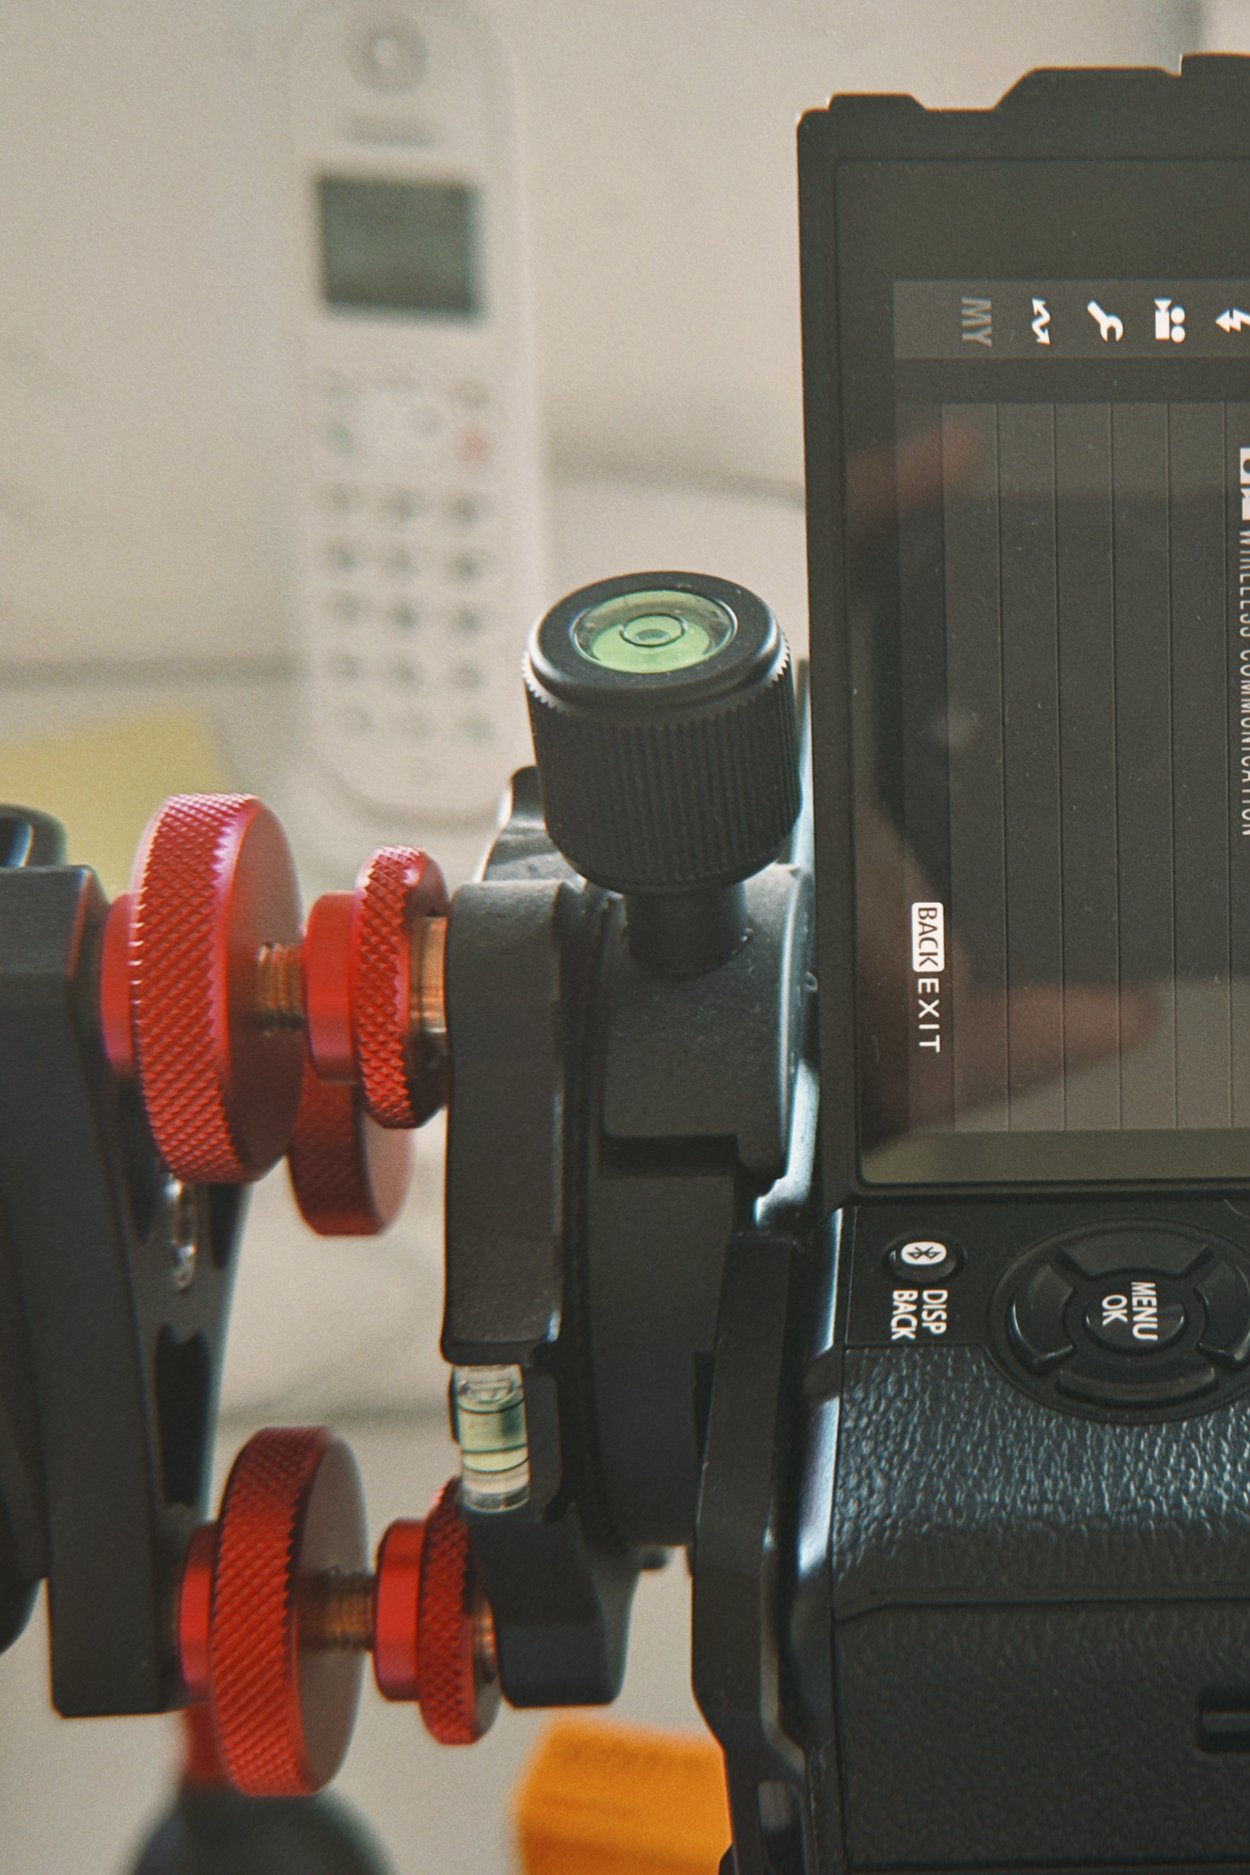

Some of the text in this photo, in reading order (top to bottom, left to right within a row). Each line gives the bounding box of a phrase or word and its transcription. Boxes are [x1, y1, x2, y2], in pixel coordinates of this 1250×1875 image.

[960, 297, 993, 347] MY
[917, 907, 941, 1053] BACK EXIT
[891, 1289, 918, 1341] BACK
[921, 1289, 949, 1336] DISP
[1101, 1294, 1128, 1327] OK
[1131, 1281, 1159, 1342] MENU
